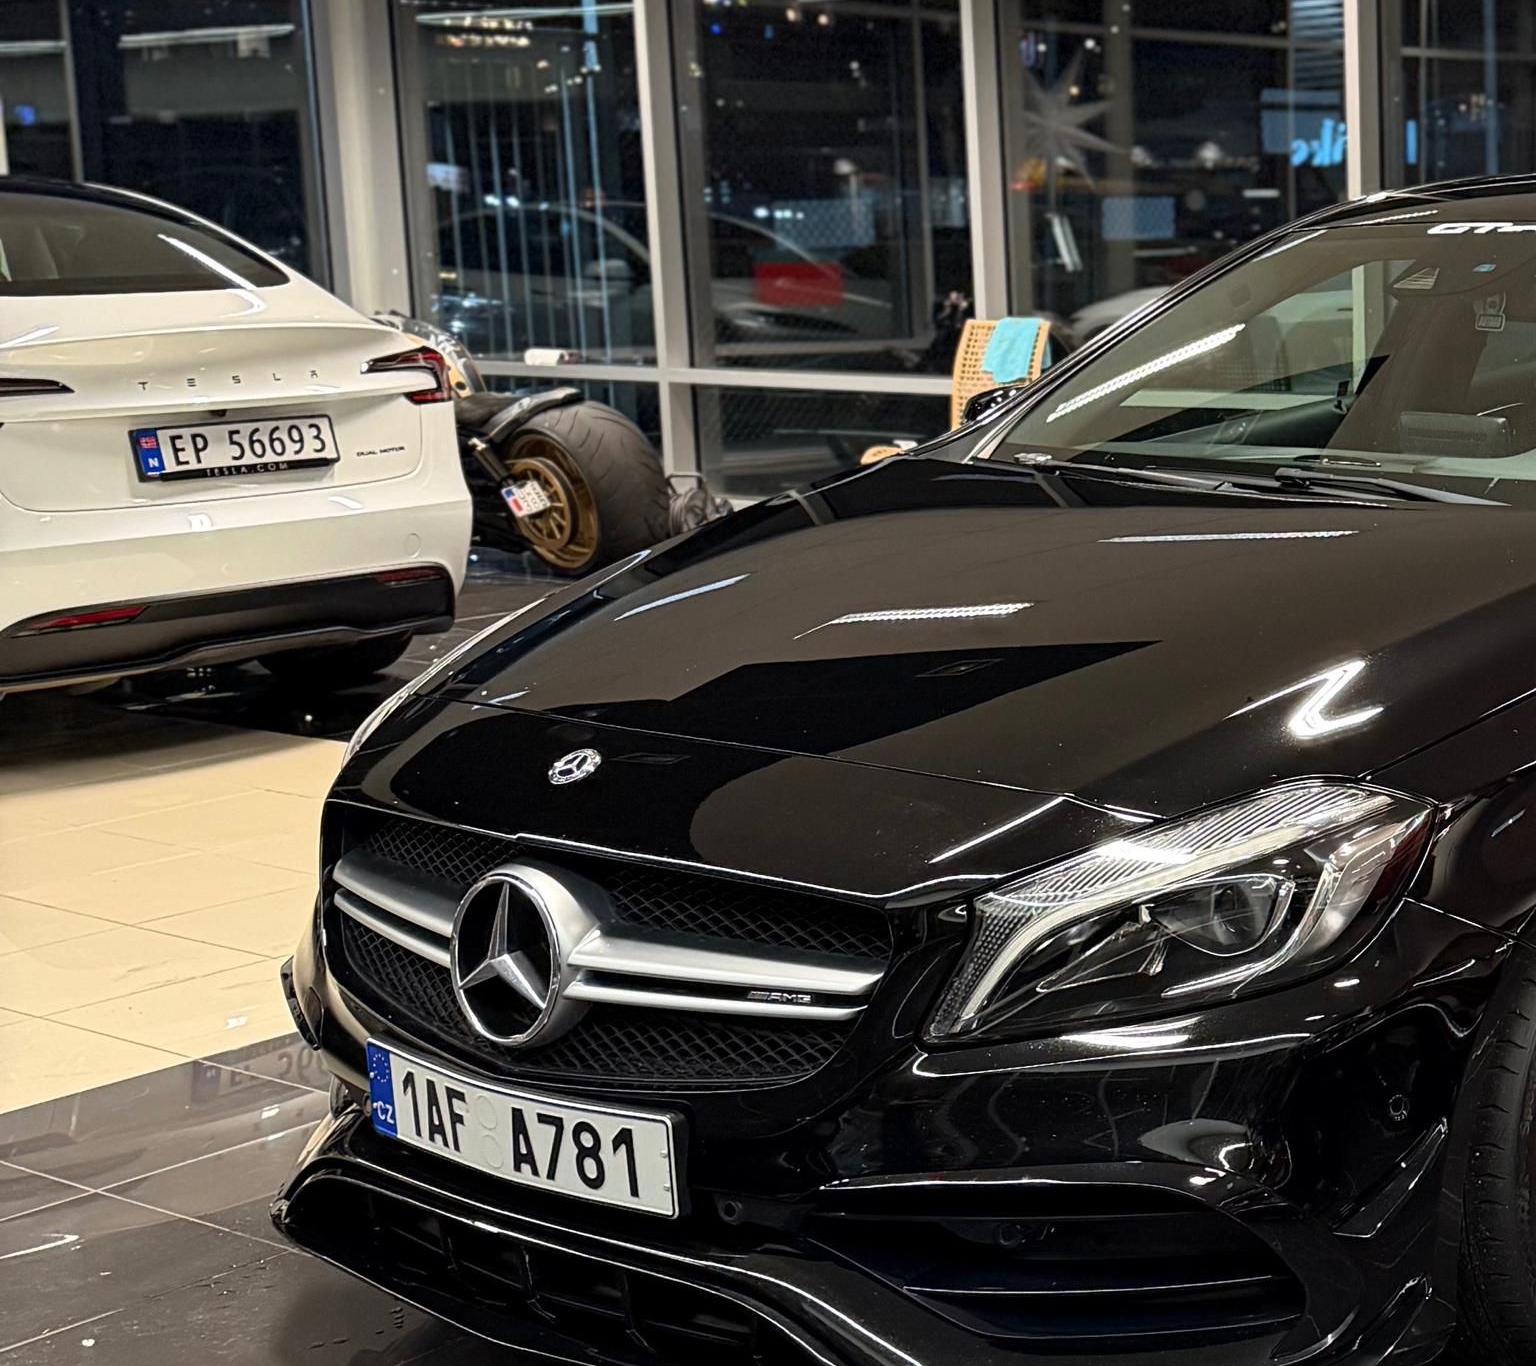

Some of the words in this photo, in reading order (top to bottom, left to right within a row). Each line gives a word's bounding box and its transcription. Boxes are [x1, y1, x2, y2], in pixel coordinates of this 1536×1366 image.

[138, 369, 319, 391] TESLA
[168, 432, 209, 467] EP
[227, 423, 327, 461] 56693
[148, 457, 159, 468] N
[767, 991, 811, 1004] AMG
[377, 1103, 395, 1125] CZ
[401, 1070, 468, 1154] 1AF
[510, 1106, 641, 1199] A781
